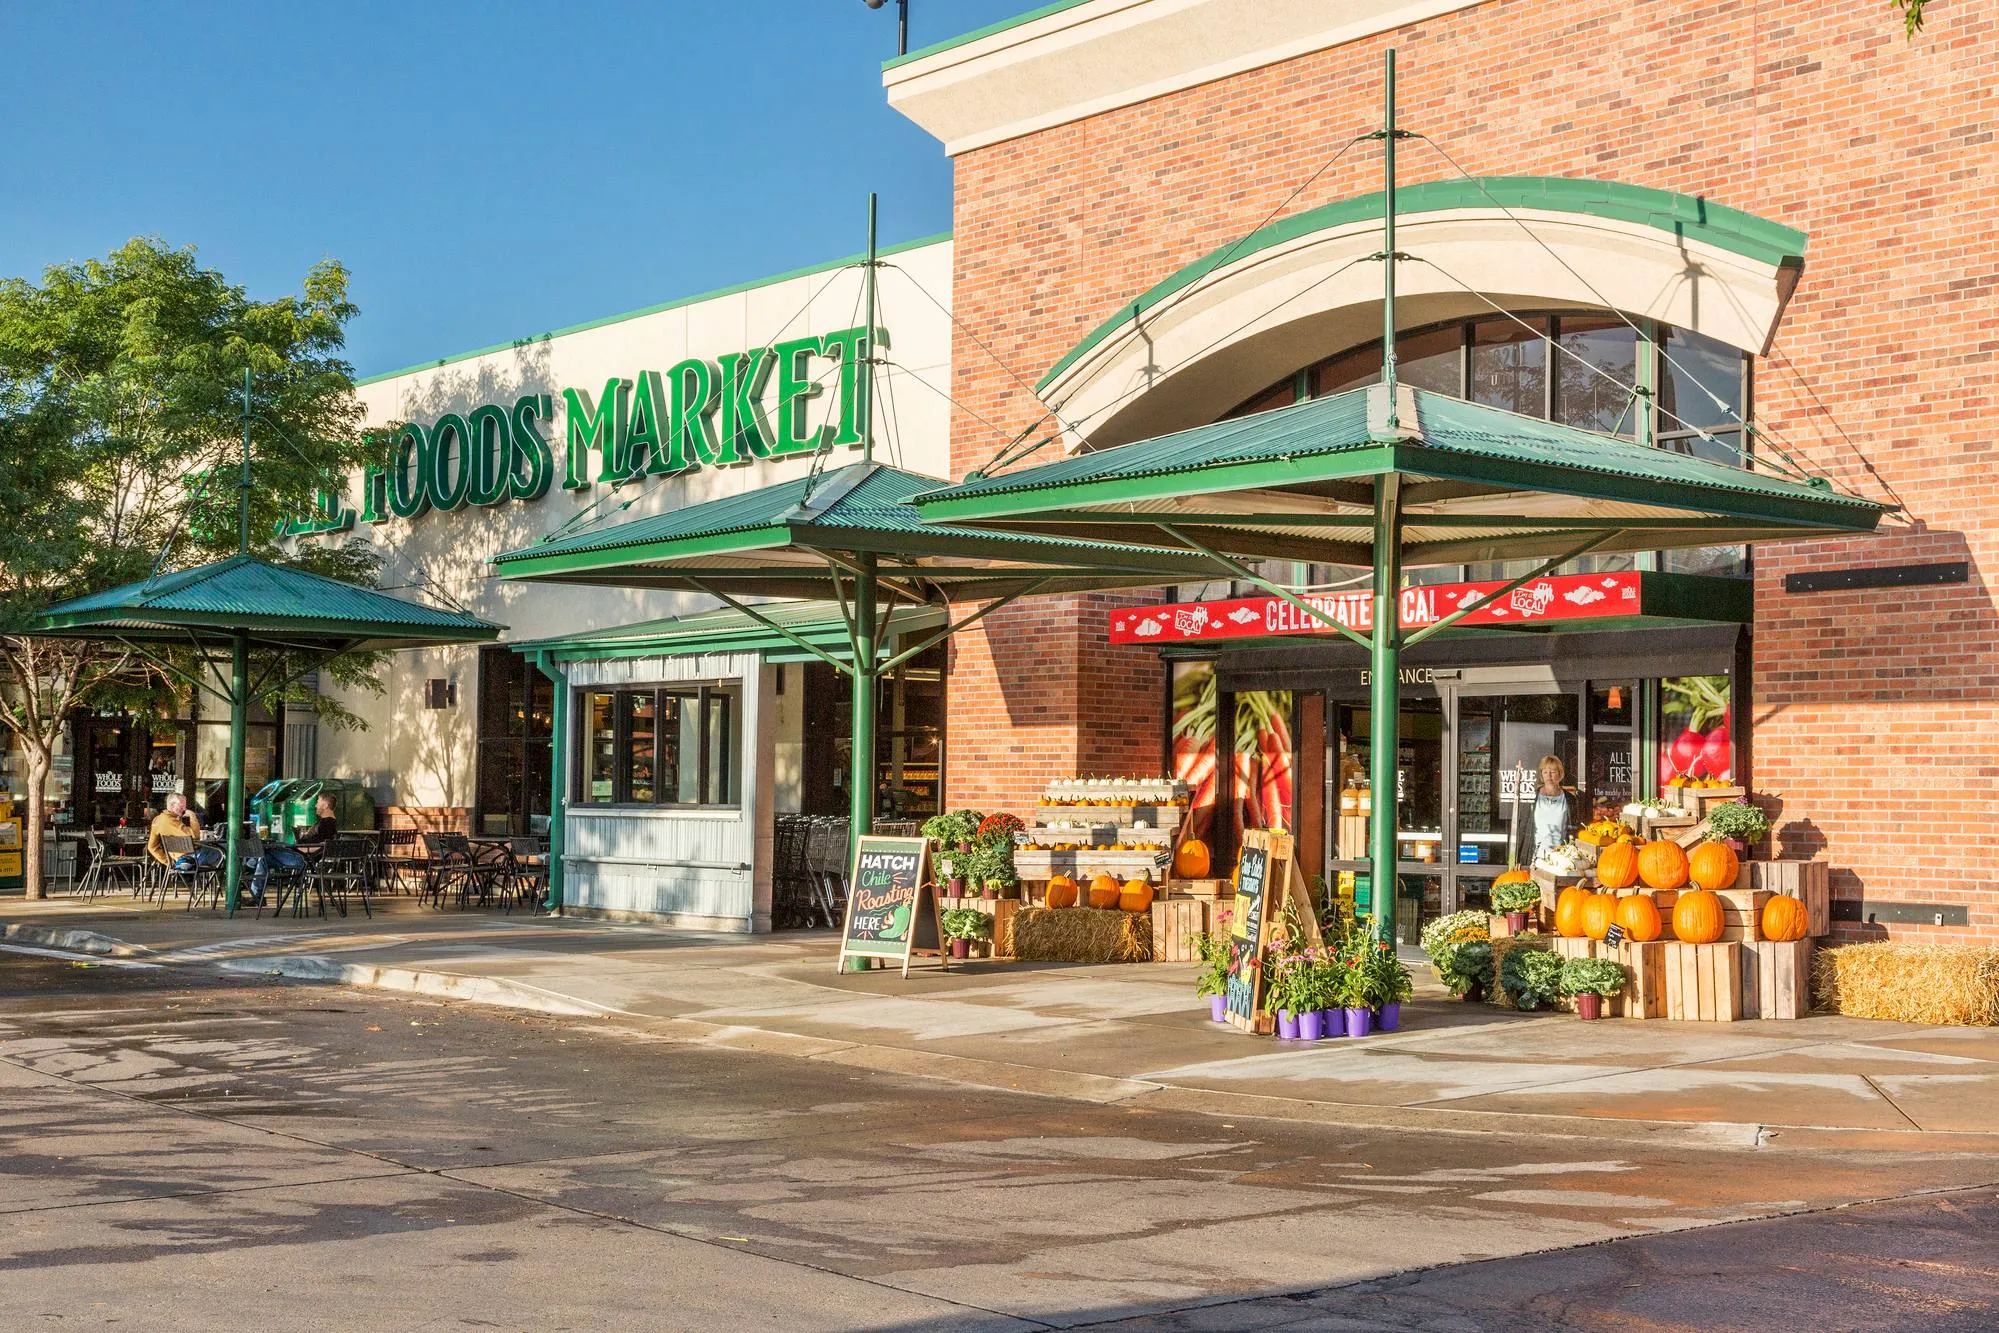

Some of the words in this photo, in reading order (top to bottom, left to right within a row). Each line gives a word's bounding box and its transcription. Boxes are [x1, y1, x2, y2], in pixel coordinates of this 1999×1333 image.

[562, 326, 891, 491] MARKET
[1266, 593, 1371, 631] CELEBRATE
[1514, 597, 1543, 612] LOCAL
[1176, 618, 1200, 631] LOCAL
[1360, 668, 1434, 686] ENANCE
[1609, 751, 1626, 765] ALL
[95, 773, 122, 781] WHOLE
[1501, 781, 1535, 793] FODS
[861, 854, 915, 870] HATCH
[862, 870, 892, 887] Chile
[856, 884, 915, 912] Roasting
[853, 915, 882, 931] HERE
